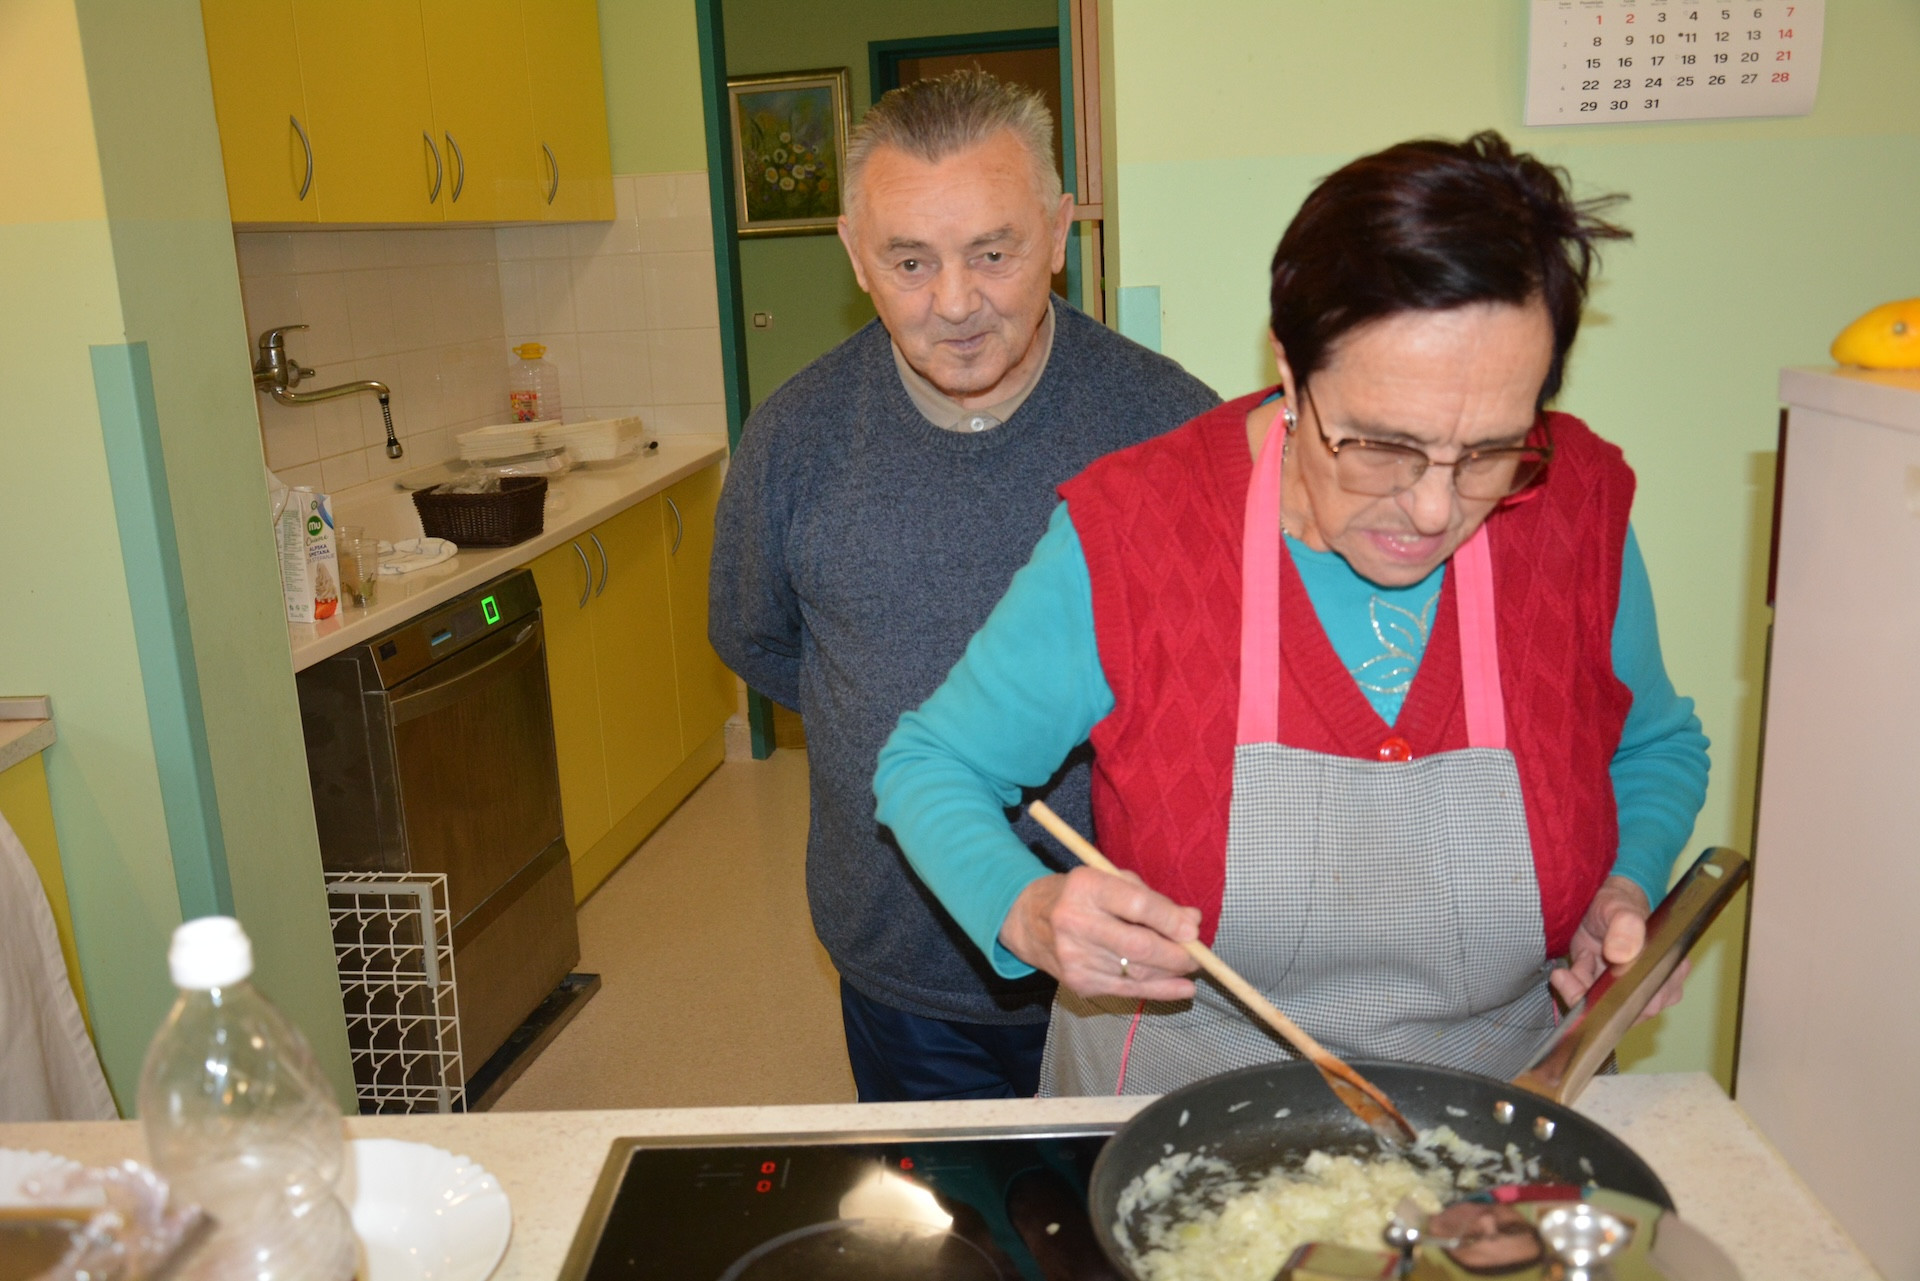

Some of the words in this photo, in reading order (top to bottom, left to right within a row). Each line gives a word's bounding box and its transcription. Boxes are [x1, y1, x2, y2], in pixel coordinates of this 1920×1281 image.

[1597, 15, 1602, 25] 1
[1626, 14, 1635, 24] 2
[1658, 12, 1666, 23] 3
[1689, 11, 1698, 21] 4
[1721, 10, 1730, 20] 5
[1753, 8, 1762, 18] 6
[1786, 7, 1795, 17] 7
[1593, 36, 1602, 47] 8
[1625, 36, 1634, 46] 9
[1650, 34, 1665, 44] 10
[1685, 33, 1697, 43] 11
[1715, 32, 1729, 42] 12
[1747, 30, 1761, 40] 13
[1779, 29, 1793, 39] 14
[1586, 58, 1601, 69] 15
[1618, 57, 1632, 67] 16
[1651, 56, 1664, 66] 17
[1682, 54, 1696, 65] 18
[1714, 53, 1728, 63] 19
[1741, 52, 1759, 63] 20
[1776, 51, 1791, 61] 21
[1582, 80, 1600, 90] 22
[1613, 79, 1631, 89] 23
[1645, 77, 1662, 88] 24
[1677, 76, 1694, 86] 25
[1708, 75, 1726, 85] 26
[1741, 73, 1758, 84] 27
[1772, 72, 1789, 83] 28
[1580, 101, 1598, 112] 29
[1610, 100, 1628, 111] 30
[1644, 99, 1659, 109] 31
